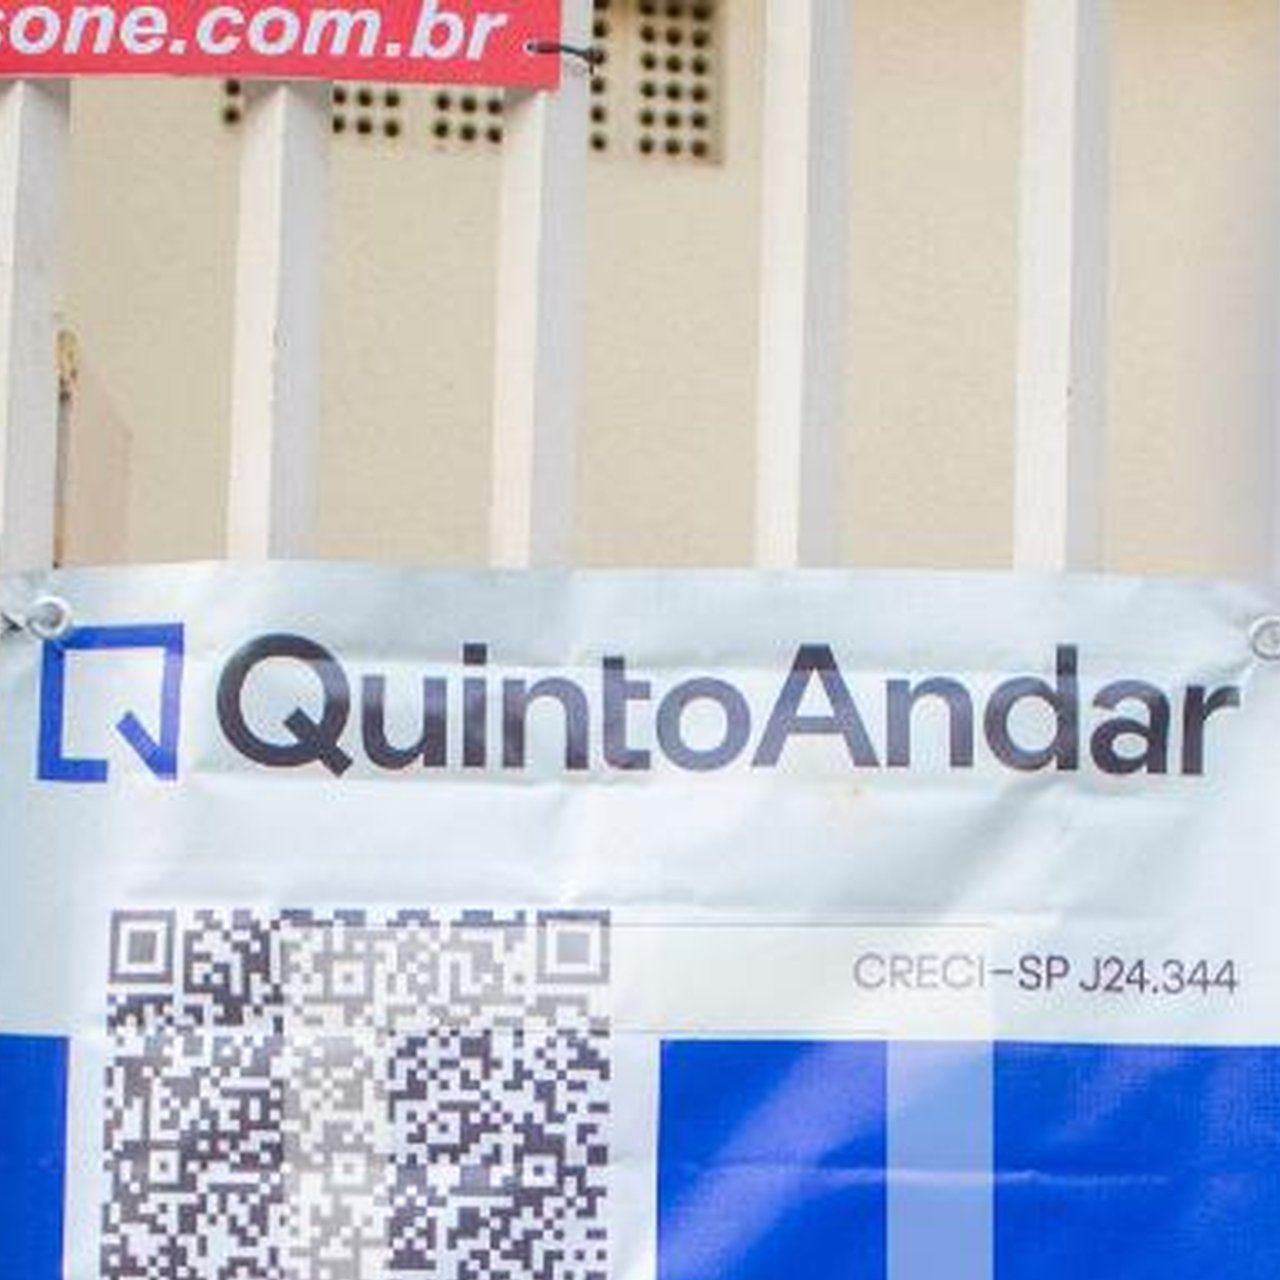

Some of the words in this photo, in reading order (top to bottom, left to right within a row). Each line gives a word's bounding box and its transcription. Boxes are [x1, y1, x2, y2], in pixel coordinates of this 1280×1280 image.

[215, 632, 1241, 777] QuintoAndar
[853, 952, 1070, 991] CRECI-SP
[1078, 955, 1238, 994] J24.344
